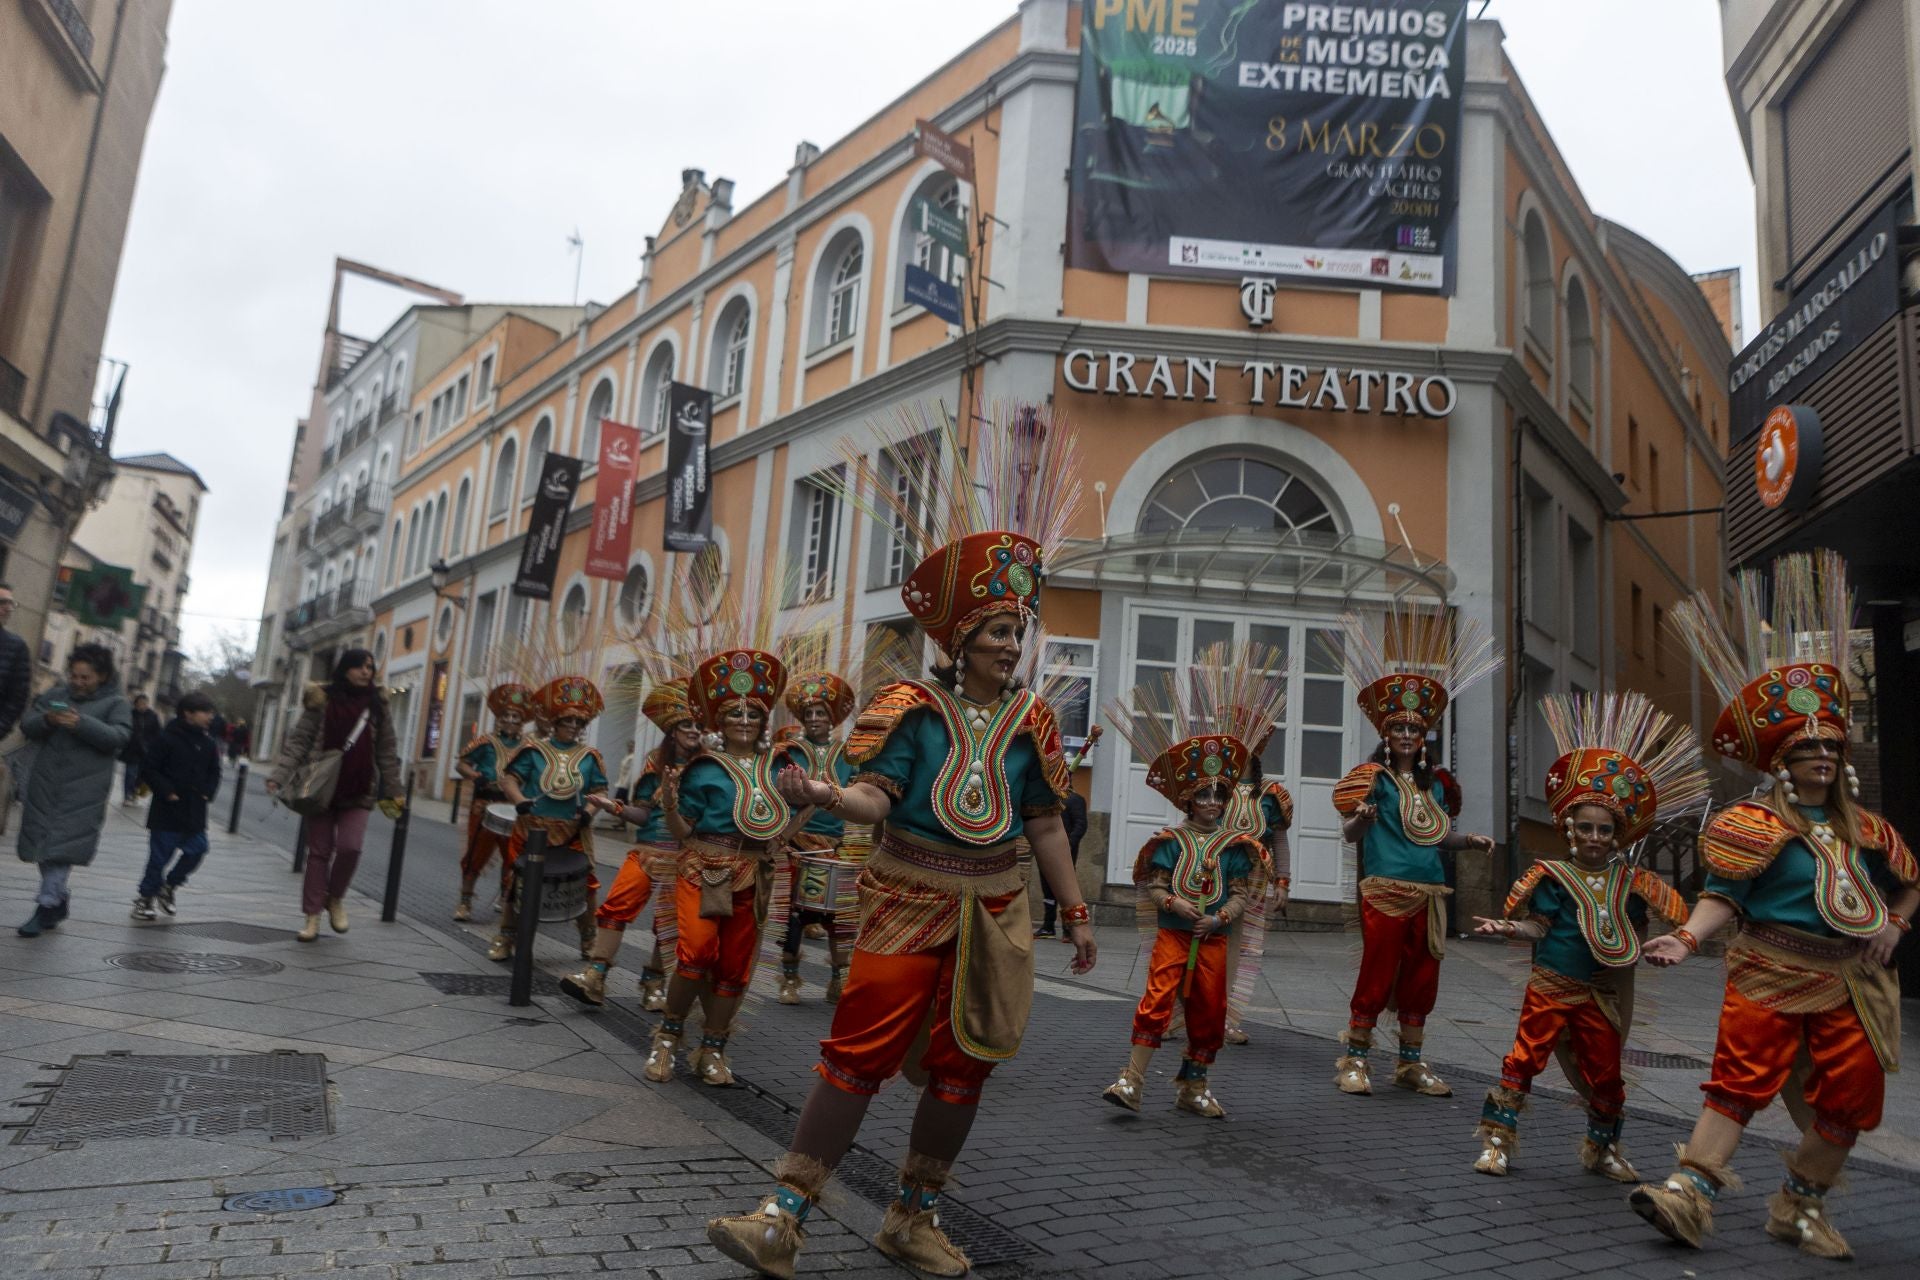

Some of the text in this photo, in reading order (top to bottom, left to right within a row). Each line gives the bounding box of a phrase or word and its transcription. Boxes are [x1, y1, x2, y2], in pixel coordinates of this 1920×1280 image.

[1094, 0, 1200, 37] PME
[1283, 4, 1447, 38] PREMIOS
[1153, 35, 1197, 57] 2025
[1306, 36, 1450, 71] MÚSICA
[1239, 61, 1451, 99] EXTREMEÑA
[1266, 117, 1446, 160] 8 MARZO
[1327, 160, 1375, 179] GRAN
[1785, 232, 1888, 343] MARGALLO
[1766, 320, 1842, 400] ABOGADOS
[1062, 347, 1458, 418] GRAN TEATRO
